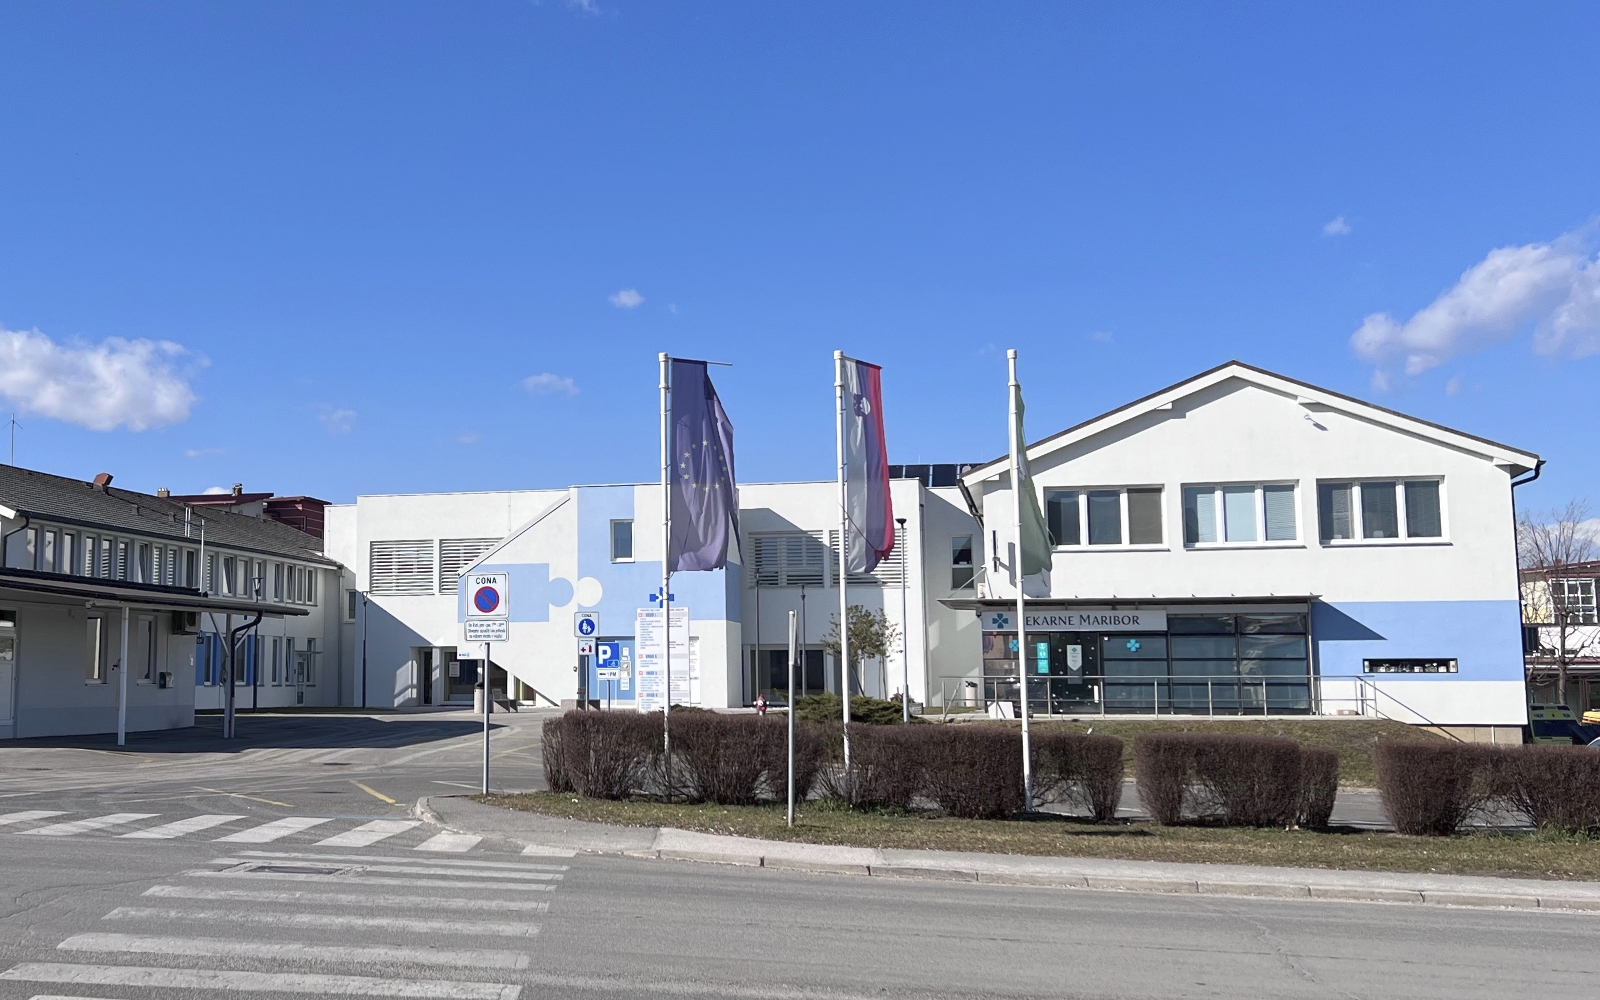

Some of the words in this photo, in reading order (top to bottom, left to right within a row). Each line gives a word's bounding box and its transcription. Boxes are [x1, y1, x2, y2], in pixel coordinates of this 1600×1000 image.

[475, 576, 497, 585] CONA
[1025, 615, 1075, 626] EKARNE
[1079, 614, 1141, 626] MARIBOR
[598, 645, 611, 665] P
